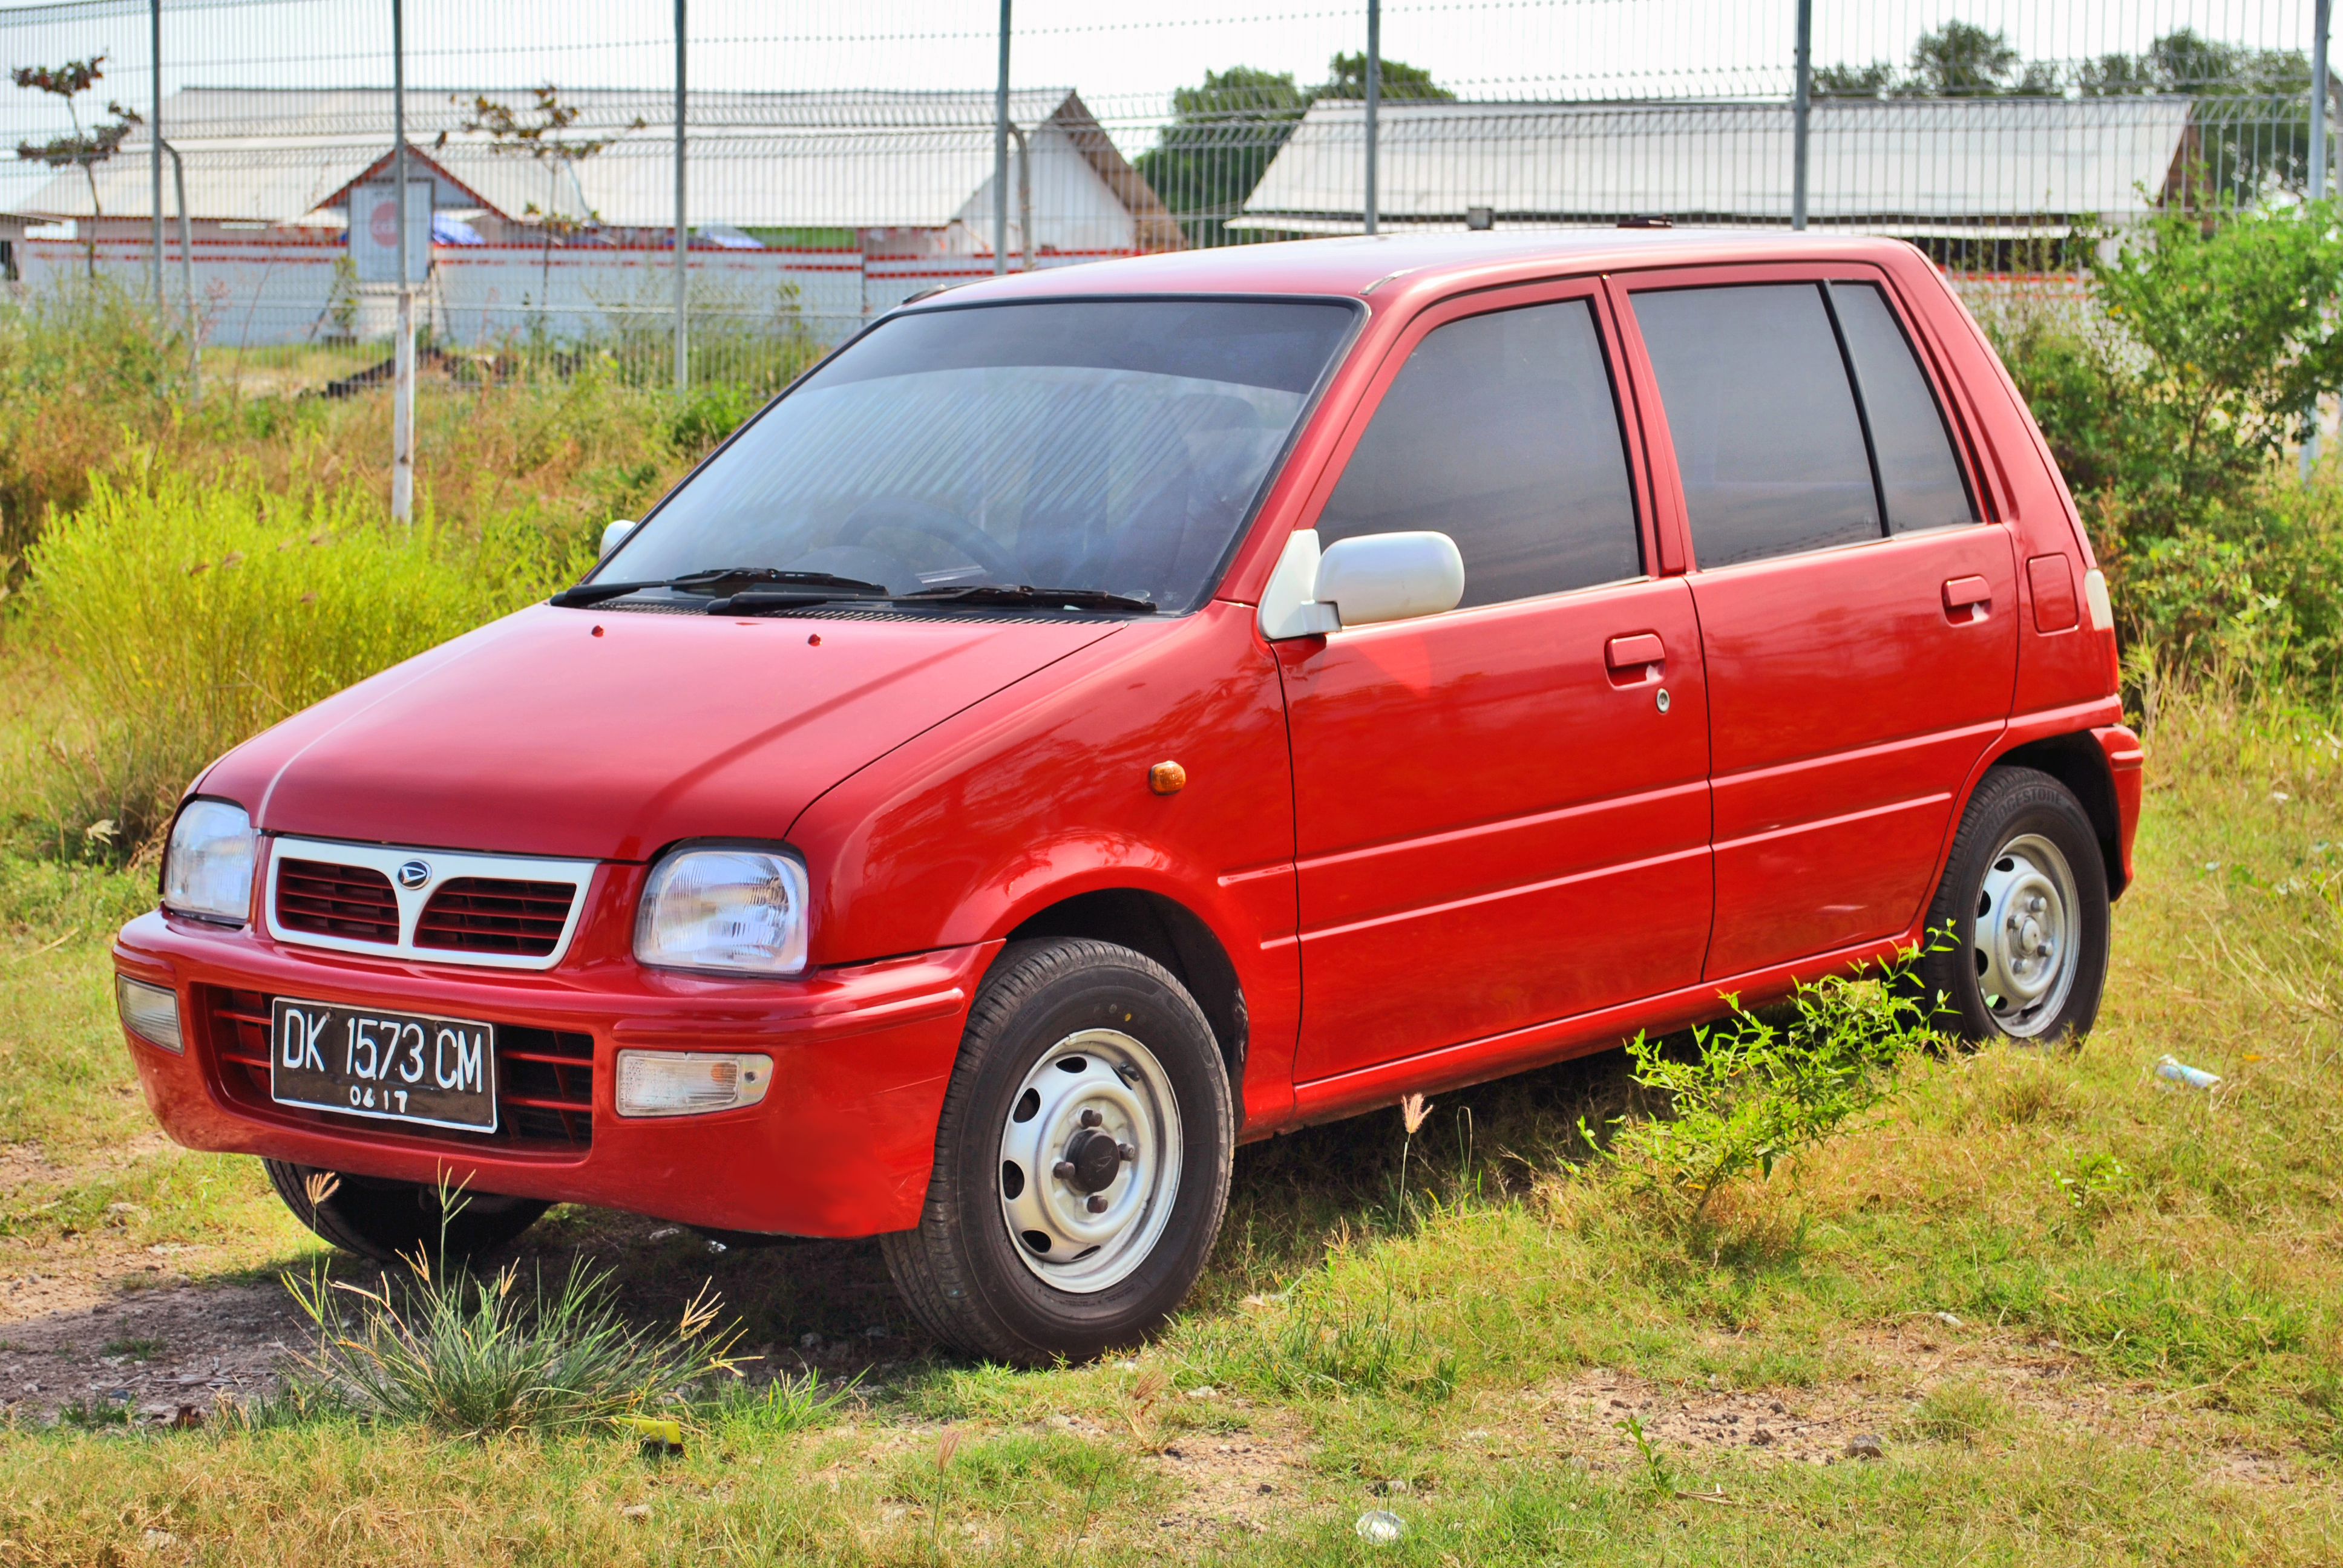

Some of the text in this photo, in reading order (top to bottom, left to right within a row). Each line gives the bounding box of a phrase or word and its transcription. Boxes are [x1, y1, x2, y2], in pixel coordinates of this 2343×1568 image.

[283, 1008, 482, 1093] DK 1573 CM
[383, 1089, 408, 1114] 17
